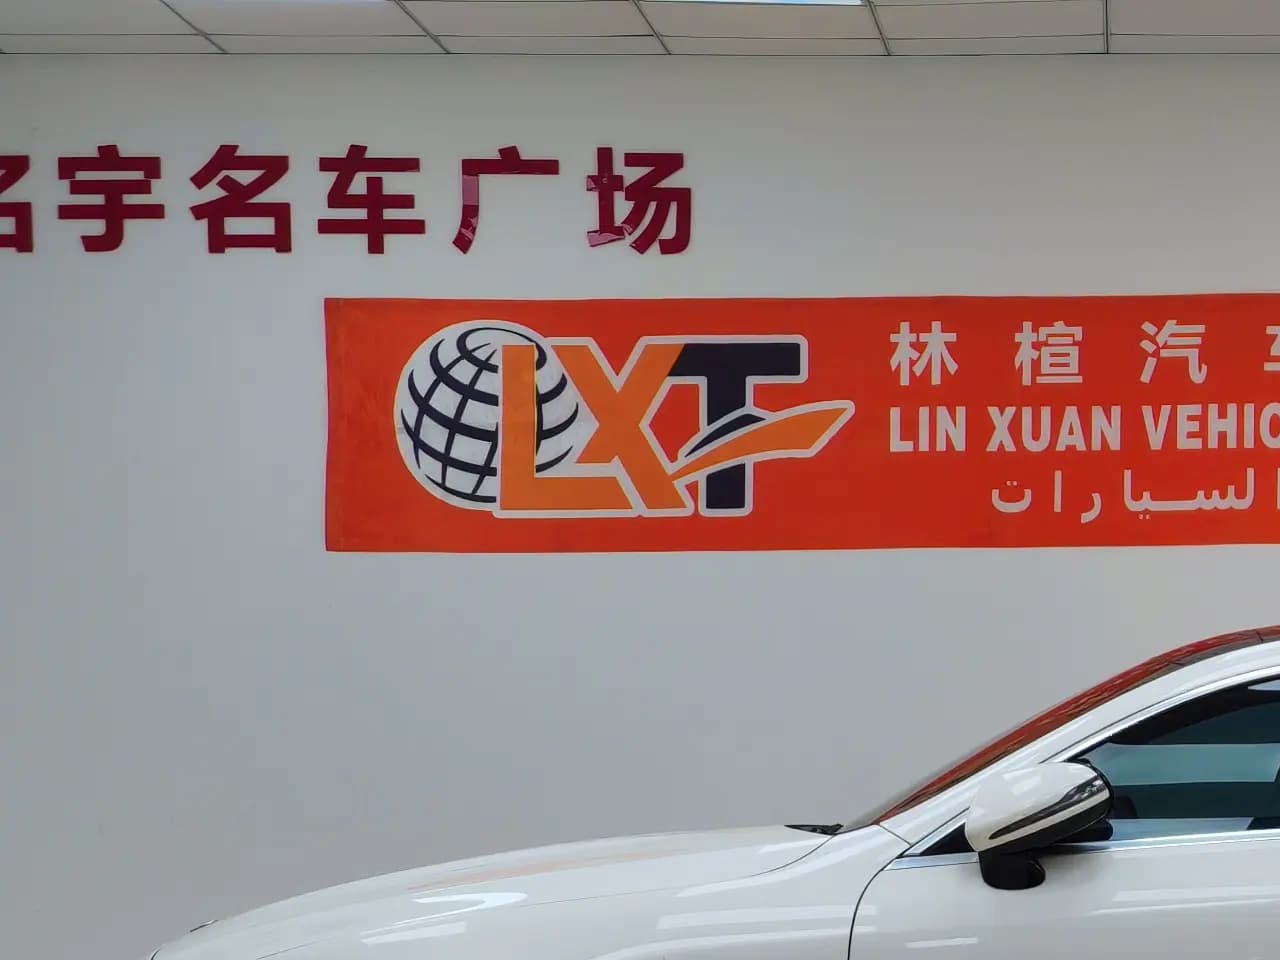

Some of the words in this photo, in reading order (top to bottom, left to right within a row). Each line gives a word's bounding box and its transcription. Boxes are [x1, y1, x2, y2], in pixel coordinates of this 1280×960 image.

[499, 340, 804, 514] LXT
[889, 406, 966, 453] LIN
[986, 405, 1121, 452] XUAN
